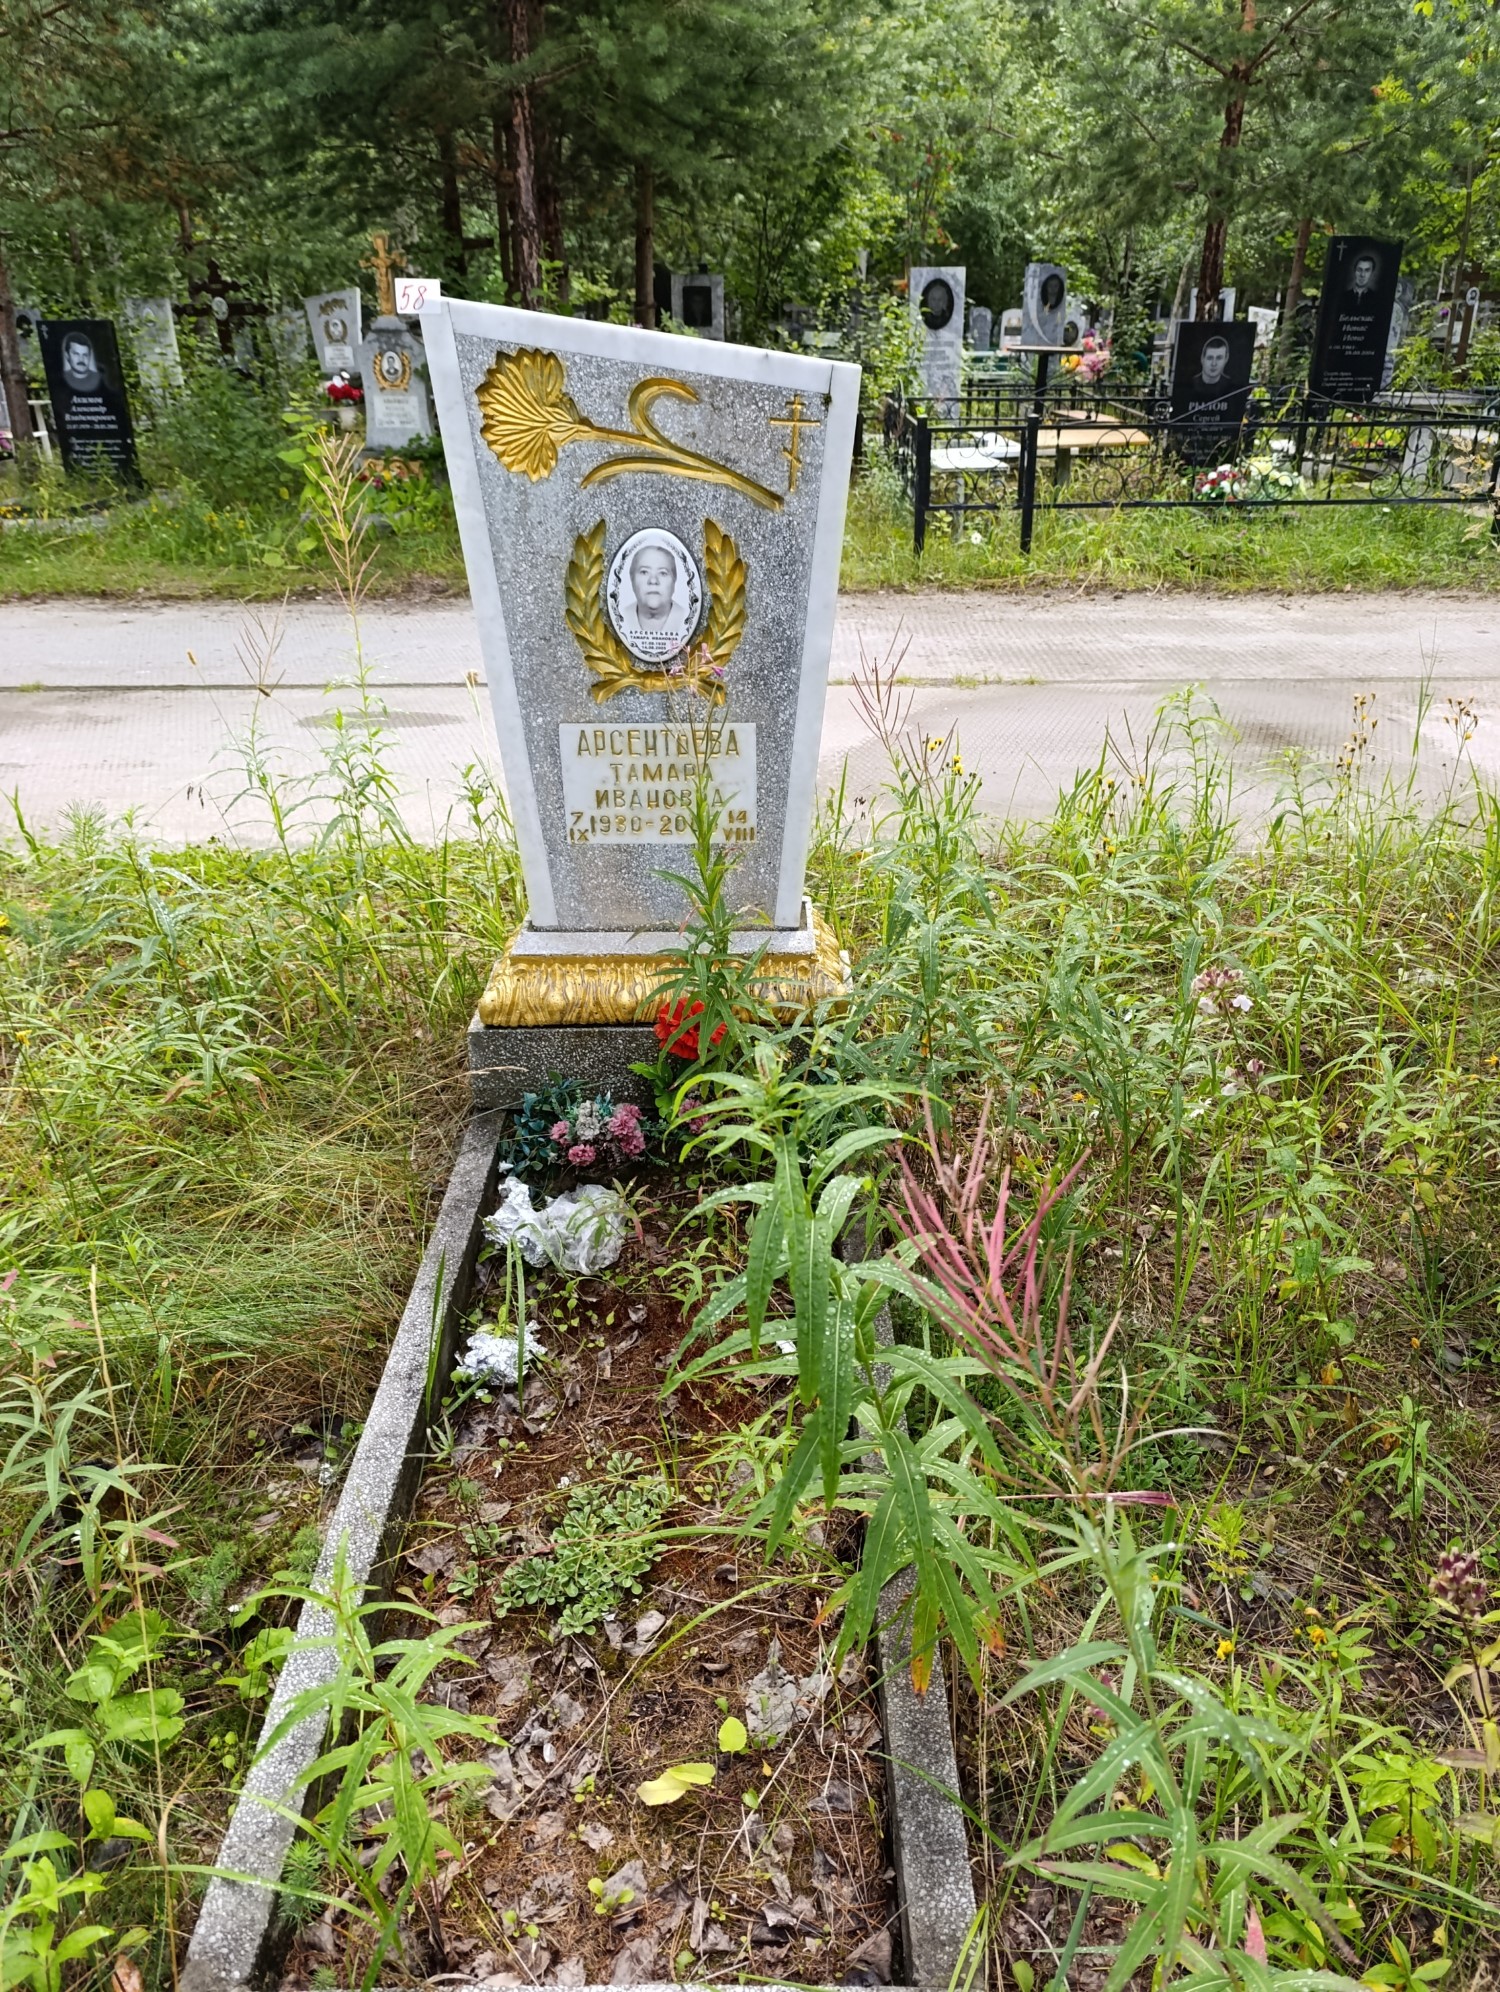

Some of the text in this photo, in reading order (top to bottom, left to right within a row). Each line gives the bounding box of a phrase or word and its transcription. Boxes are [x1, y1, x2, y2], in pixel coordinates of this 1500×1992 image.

[400, 285, 427, 310] 58
[577, 729, 740, 758] АРСЕНТЬЕВА
[595, 788, 724, 810] ИВАНОВА
[727, 810, 747, 825] 14
